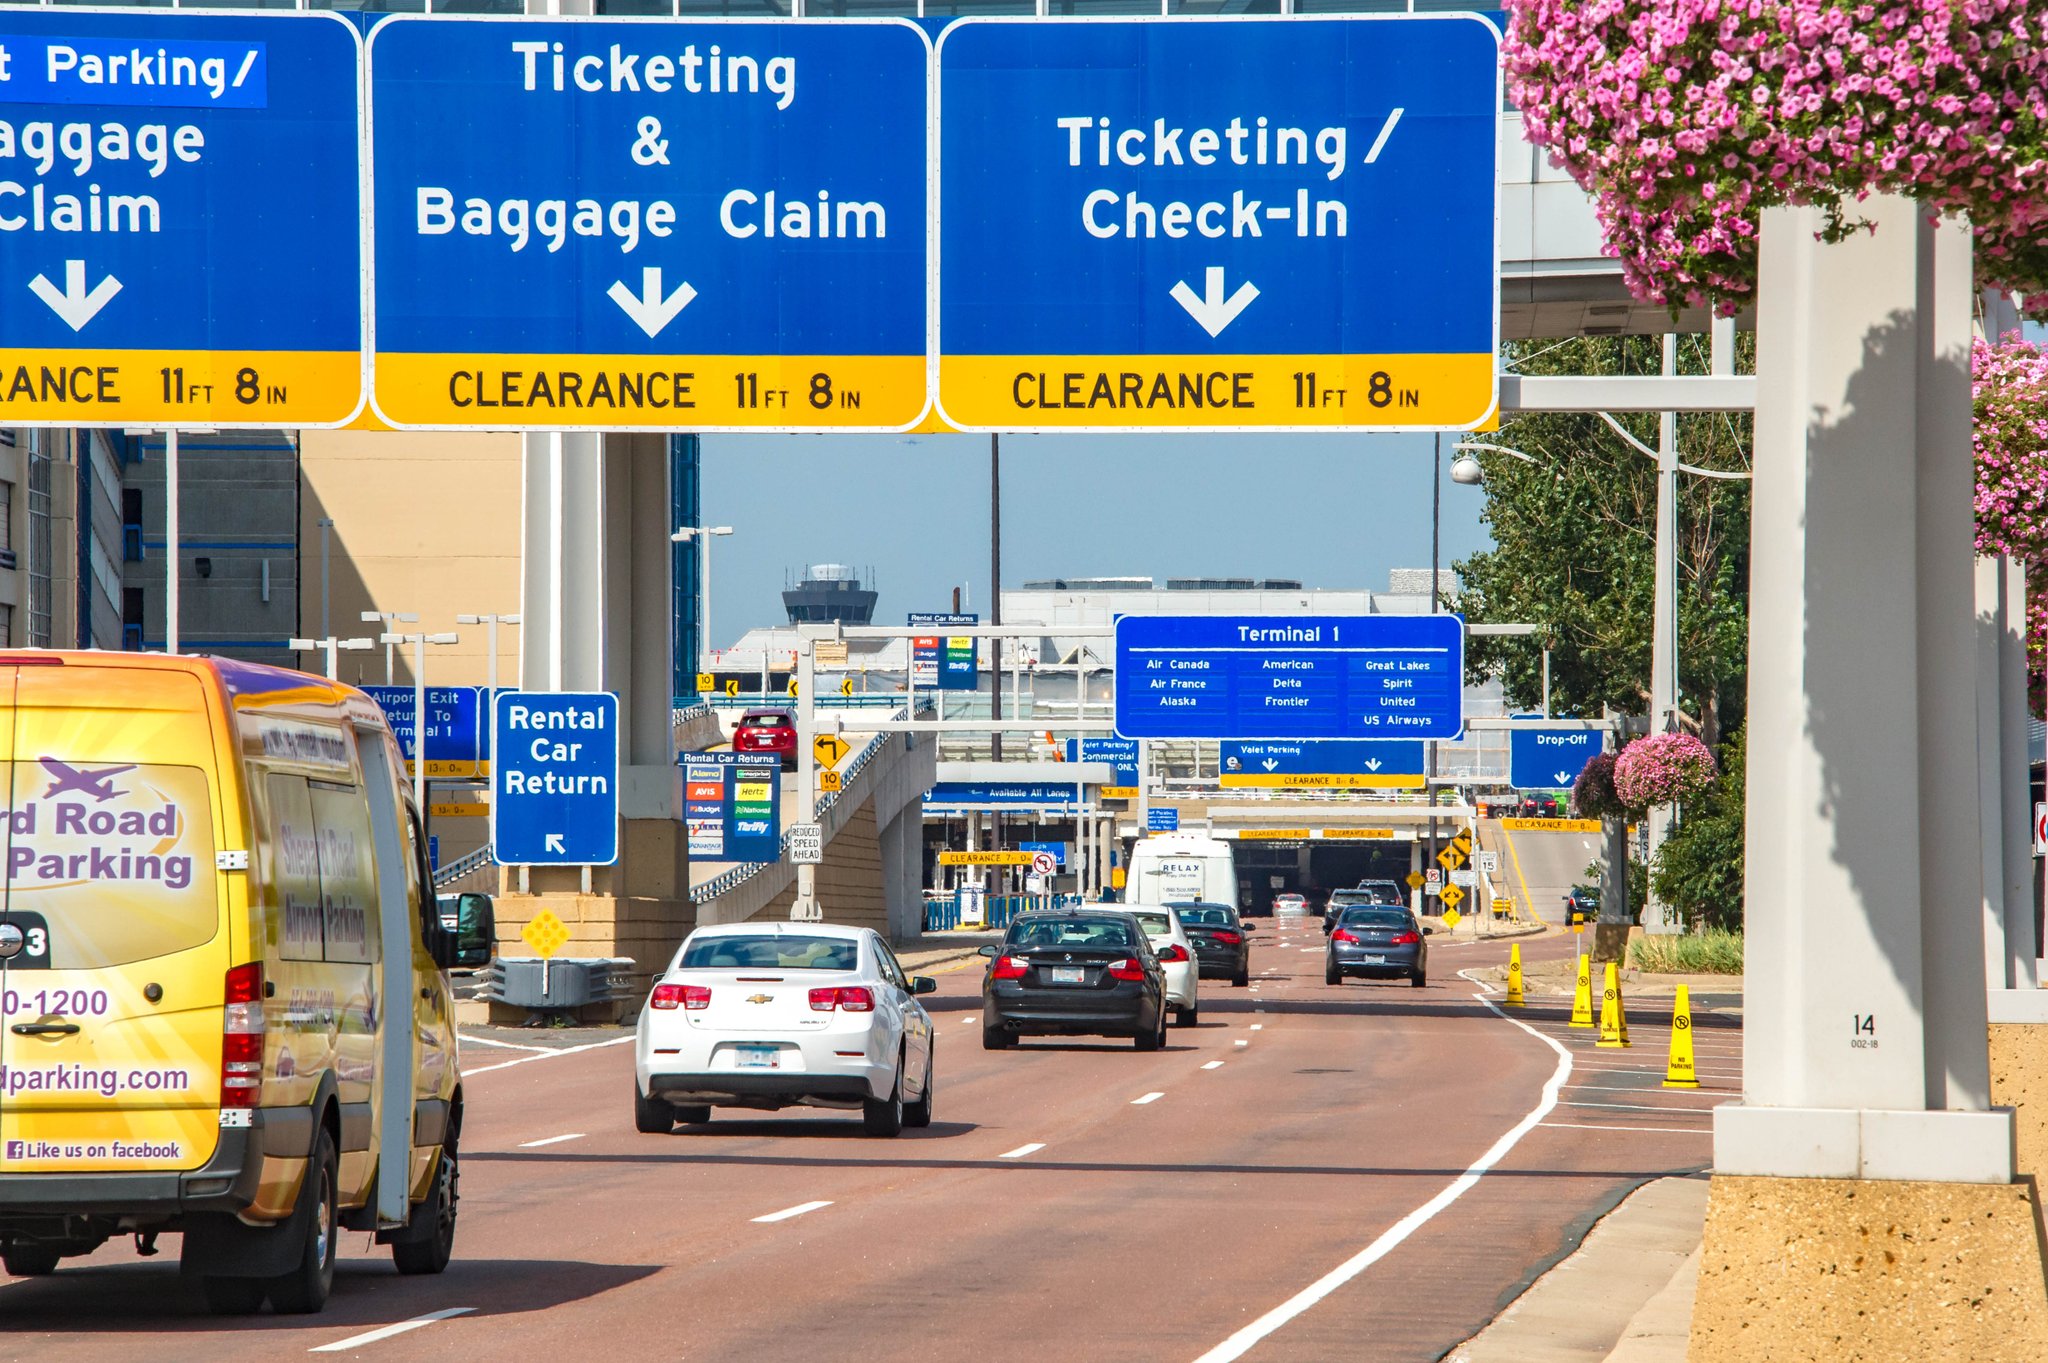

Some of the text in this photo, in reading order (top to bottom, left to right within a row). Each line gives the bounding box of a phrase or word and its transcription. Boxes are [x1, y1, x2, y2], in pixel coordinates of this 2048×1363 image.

[47, 45, 258, 96] Parking/
[512, 41, 796, 110] Ticketing
[631, 116, 670, 165] &
[0, 120, 204, 177] aggage
[1057, 116, 1347, 180] Ticketing
[0, 181, 160, 232] Claim
[1082, 189, 1347, 238] Check-In
[416, 187, 886, 253] Baggage Claim
[0, 366, 120, 403] ANCE
[449, 371, 694, 408] CLEARANCE
[1012, 372, 1254, 408] CLEARANCE
[1238, 626, 1340, 642] Terminal 1
[1147, 659, 1210, 670] Air Canada
[1262, 659, 1314, 670] American
[1366, 660, 1430, 671] Great Lakes
[701, 676, 710, 684] 10
[1150, 678, 1206, 689] Air France
[1273, 678, 1302, 688] Delta
[1383, 678, 1413, 690] Spirit
[373, 692, 459, 705] Airpor Exit
[1160, 696, 1196, 707] Alaska
[1265, 696, 1309, 707] Frontier
[1380, 696, 1415, 707] United
[383, 710, 415, 721] etur
[434, 710, 451, 722] To
[508, 706, 605, 731] Rental
[1364, 715, 1432, 727] US Airways
[446, 726, 452, 737] 1
[1537, 734, 1588, 746] Drop-Off
[530, 738, 582, 762] Car
[1241, 746, 1300, 756] Valet Parking
[684, 754, 714, 762] Rental
[738, 755, 774, 763] Returns
[1082, 752, 1134, 761] Commercial
[1117, 763, 1139, 771] ONLY
[506, 769, 607, 795] Return
[825, 773, 837, 784] 10
[1284, 777, 1329, 785] CLEARANCE
[989, 788, 1026, 797] Available
[1031, 789, 1042, 797] All
[1046, 789, 1070, 798] Lanes
[697, 805, 720, 813] Budget
[56, 803, 175, 835] Road
[1515, 820, 1562, 829] CLEARANCE
[737, 822, 769, 834] Thrifty
[792, 827, 820, 837] REDUCED
[794, 839, 818, 847] SPEED
[793, 850, 819, 859] AHEAD
[950, 854, 1000, 862] CLEARANCE
[9, 847, 191, 888] Parking
[1483, 861, 1494, 870] 15
[326, 894, 365, 956] Parking
[26, 928, 46, 956] 3
[3, 990, 107, 1015] 0-1200
[1854, 1014, 1875, 1035] 14
[1851, 1039, 1878, 1048] 002-18
[0, 1064, 188, 1096] dparking.com
[28, 1143, 60, 1158] Like
[65, 1145, 82, 1158] us
[87, 1145, 106, 1158] on
[112, 1142, 180, 1158] facebook
